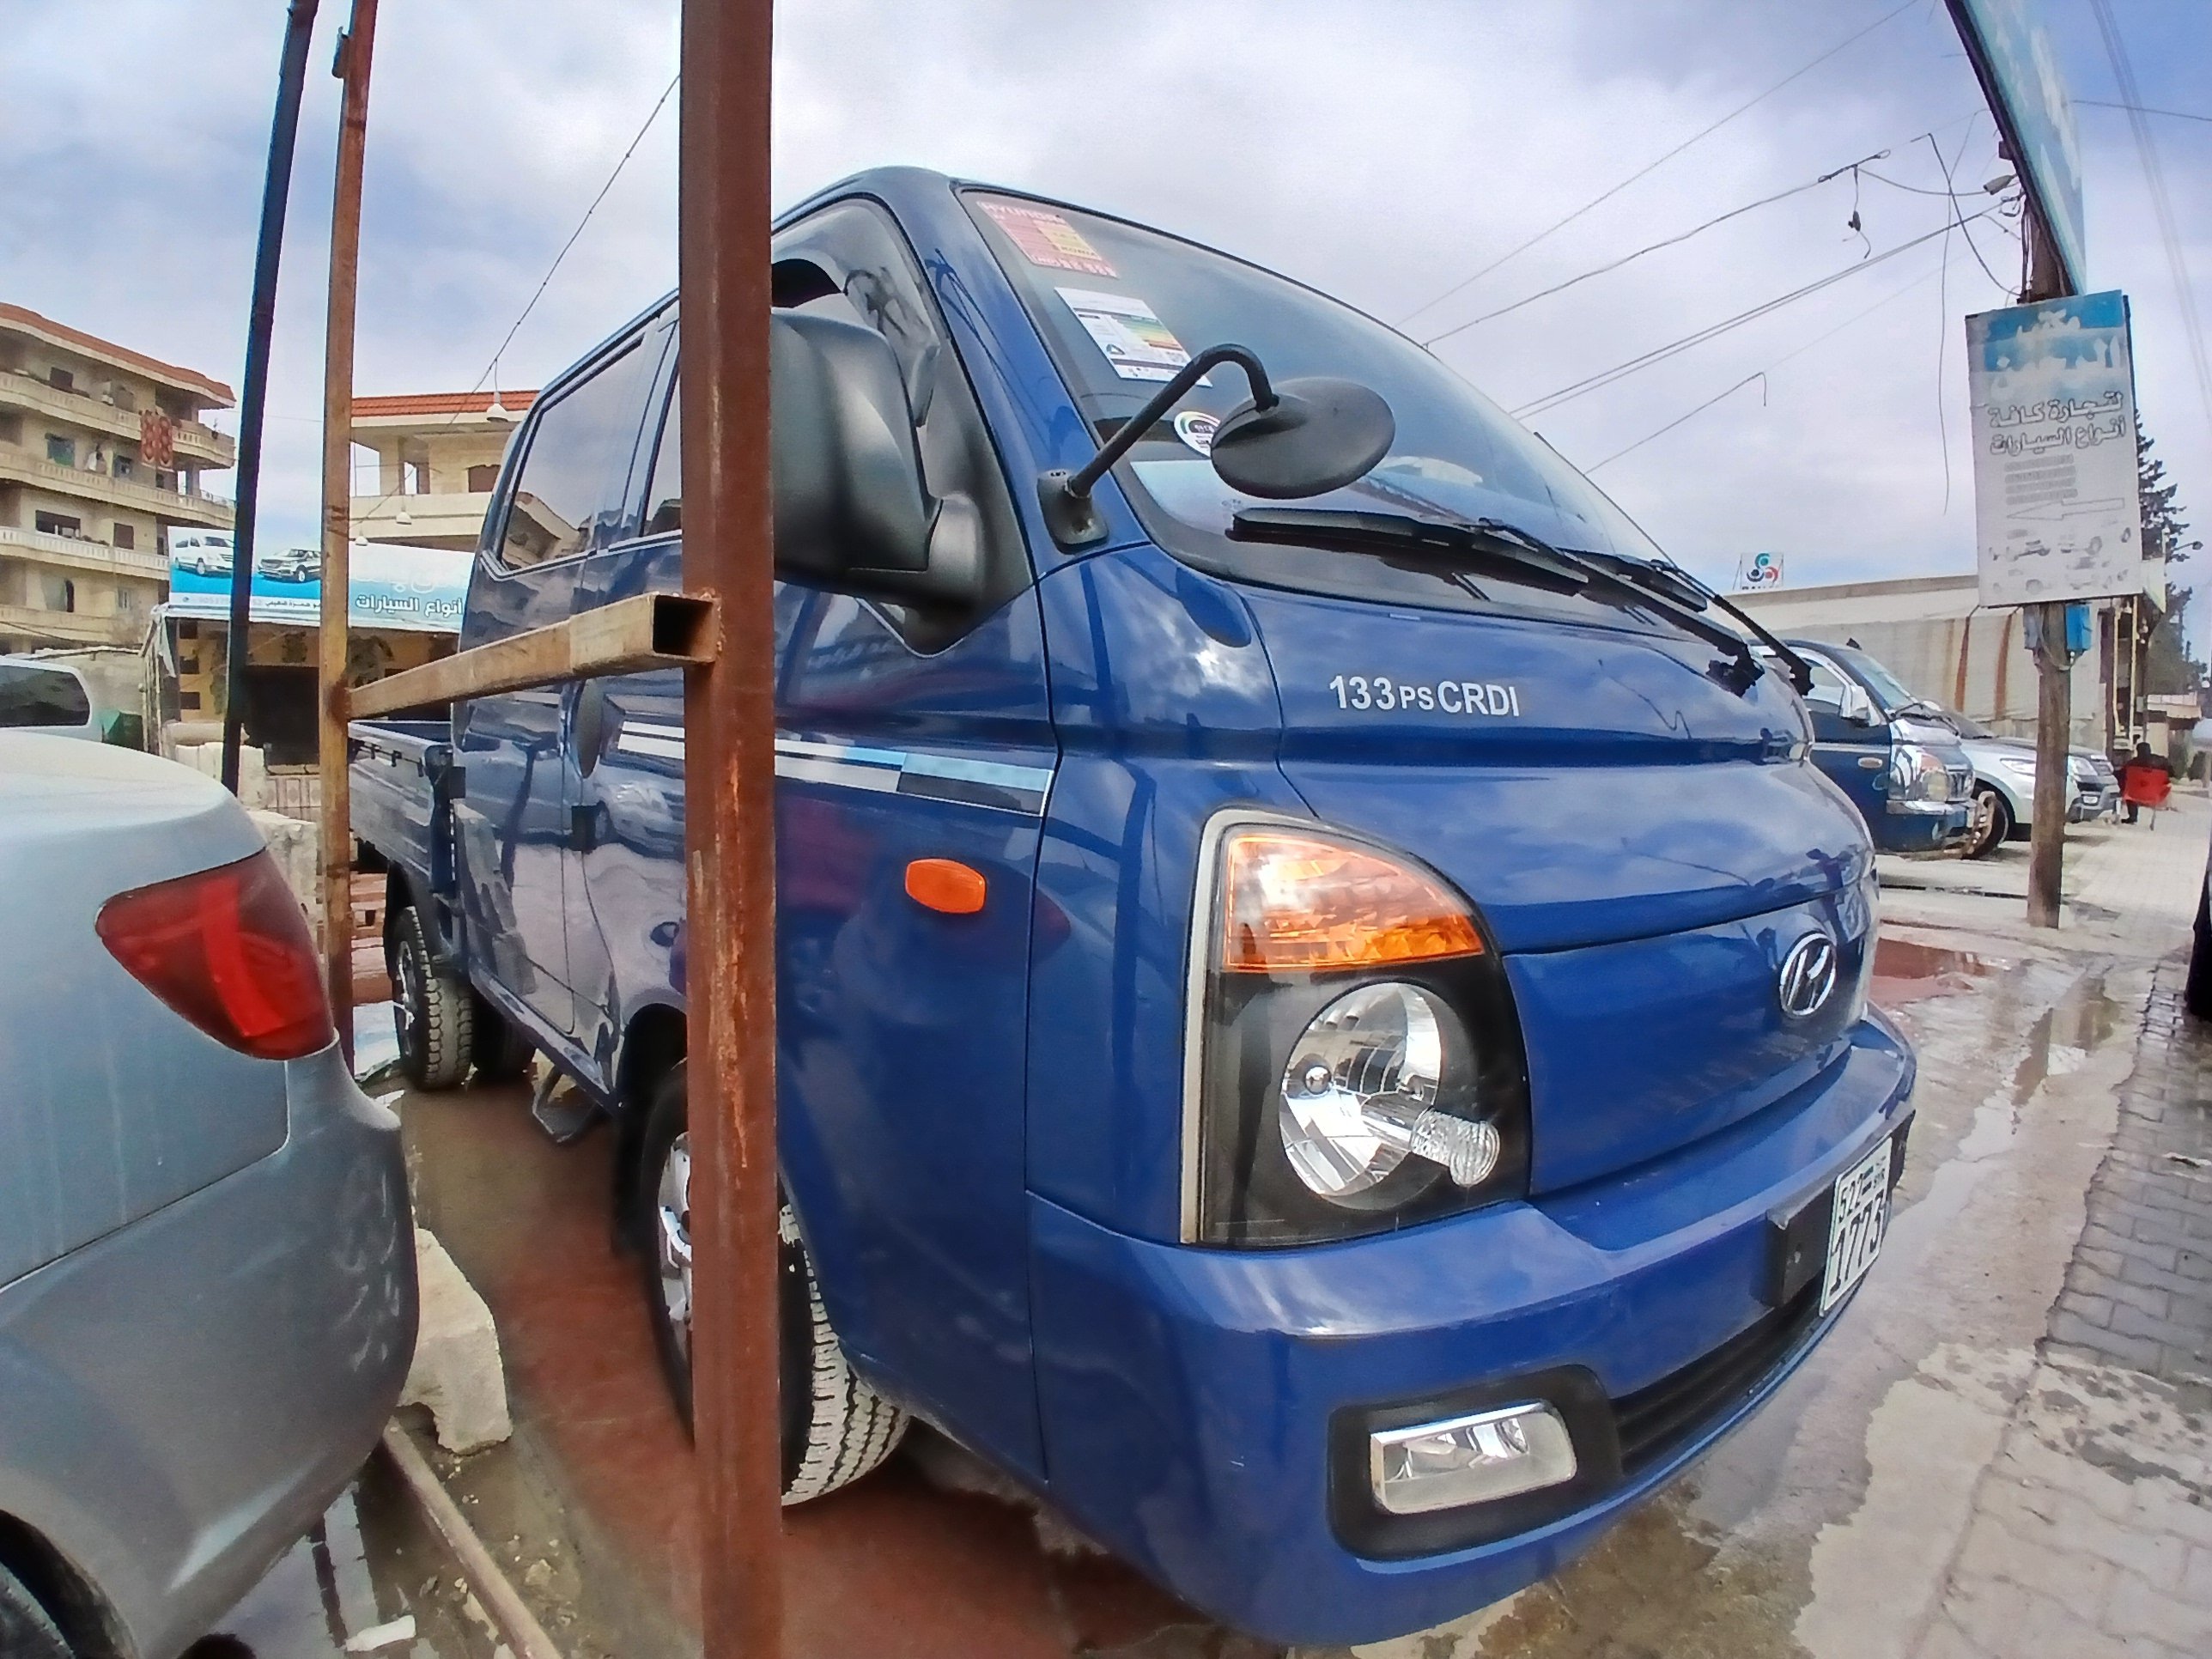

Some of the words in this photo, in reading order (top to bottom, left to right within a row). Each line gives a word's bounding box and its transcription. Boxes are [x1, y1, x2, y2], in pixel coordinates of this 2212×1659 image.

[1988, 402, 2045, 428] كافة
[2048, 391, 2124, 422] لتجارة
[1990, 426, 2073, 457] السيارات
[356, 594, 420, 615] السيارات
[1829, 1188, 1885, 1296] 1773
